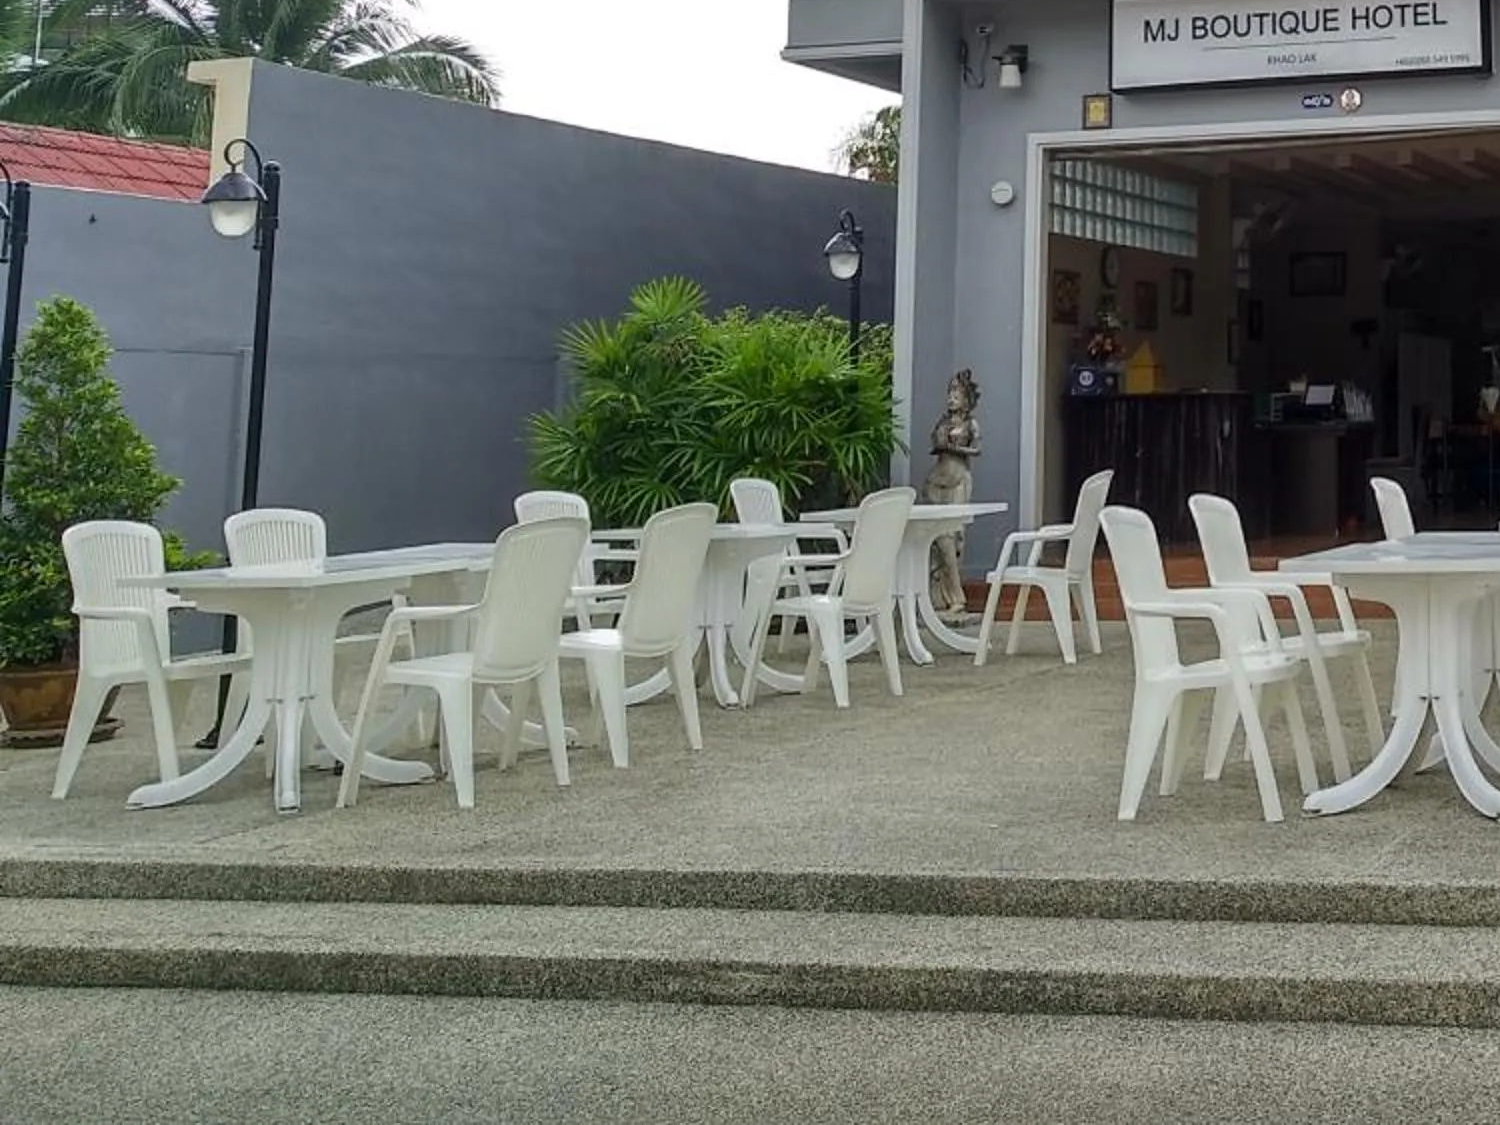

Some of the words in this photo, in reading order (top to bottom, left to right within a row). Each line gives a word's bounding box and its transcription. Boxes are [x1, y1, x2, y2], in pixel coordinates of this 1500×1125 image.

[1143, 17, 1180, 44] MJ
[1191, 8, 1341, 41] BOUTIQUE
[1351, 2, 1448, 31] HOTEL
[1267, 53, 1297, 65] KHAO
[1298, 53, 1317, 64] LAK
